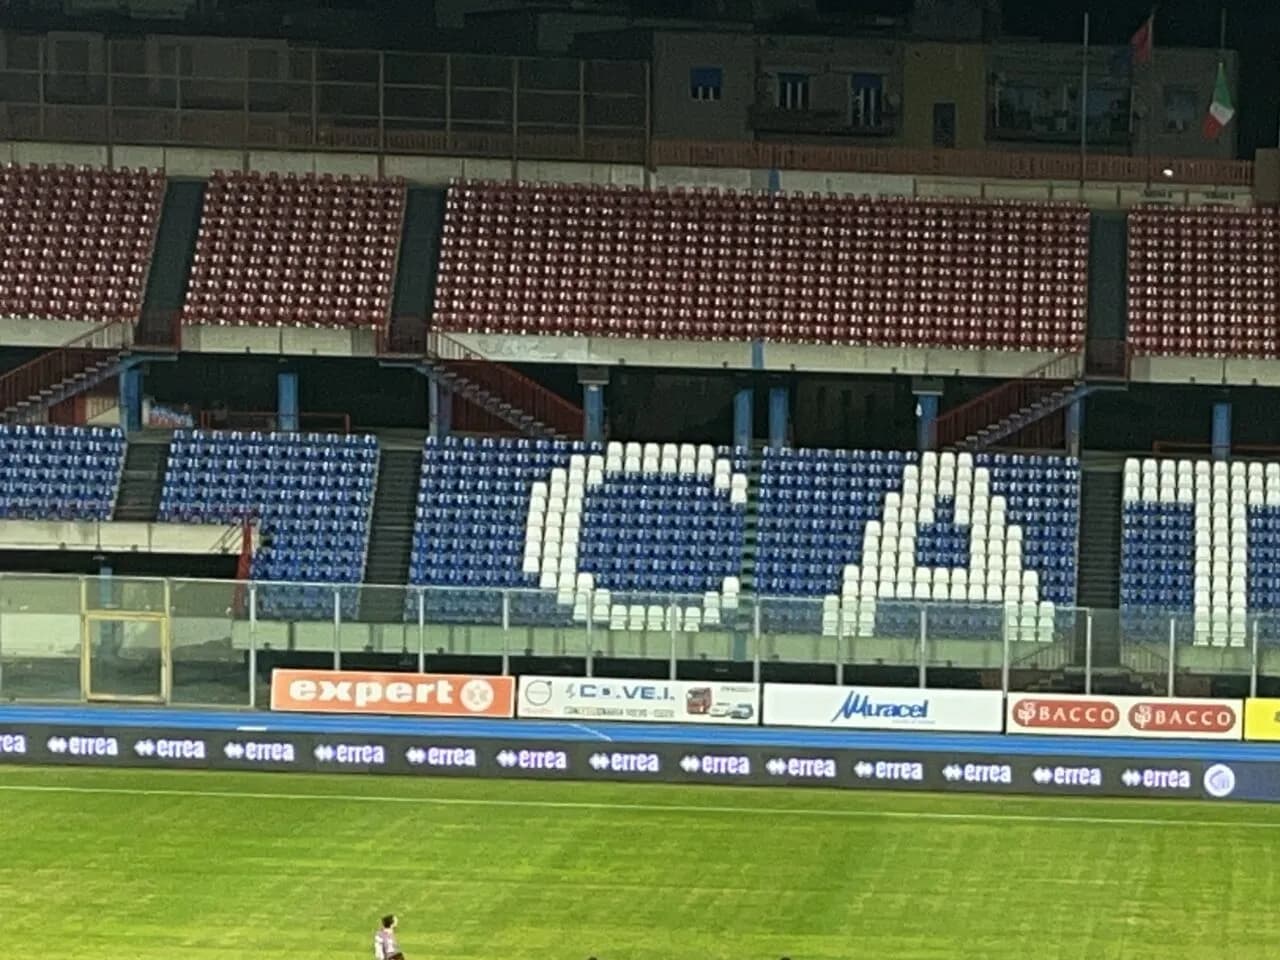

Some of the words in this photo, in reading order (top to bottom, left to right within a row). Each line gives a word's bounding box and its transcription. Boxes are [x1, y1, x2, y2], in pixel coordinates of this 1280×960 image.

[288, 679, 454, 708] expert
[1038, 706, 1116, 723] BACCO
[1154, 709, 1232, 726] BACCO
